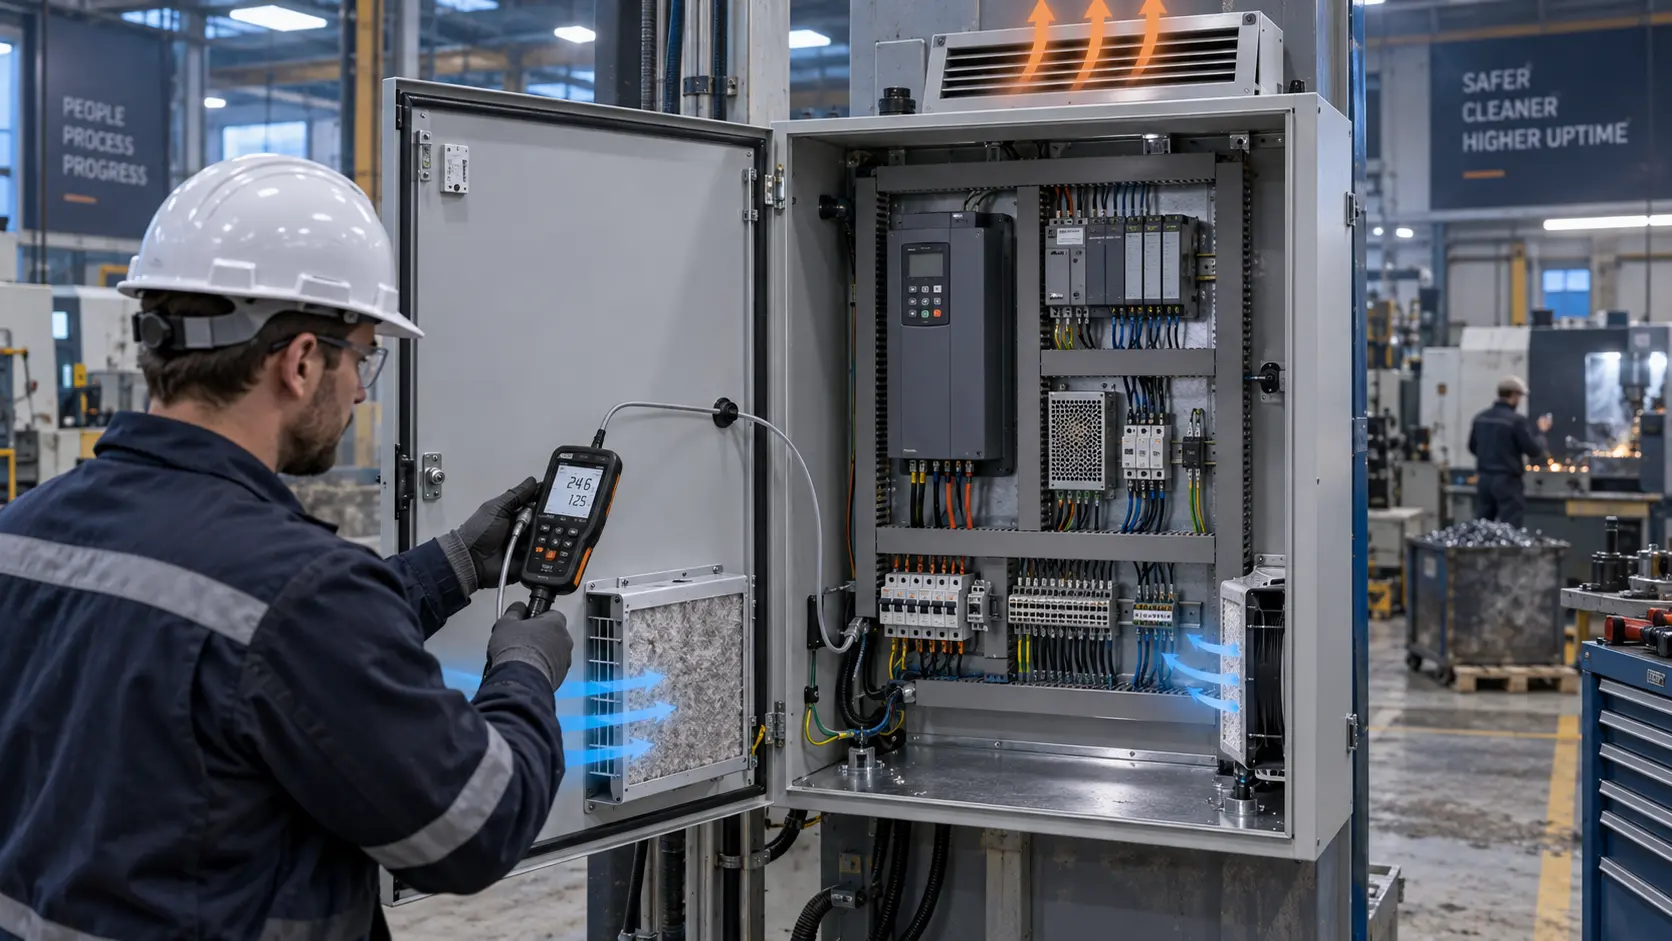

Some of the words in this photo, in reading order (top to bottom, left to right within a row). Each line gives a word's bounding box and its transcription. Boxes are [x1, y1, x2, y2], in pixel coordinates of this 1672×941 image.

[1462, 67, 1531, 93] SAFER
[63, 96, 126, 127] PEOPLE
[1462, 97, 1558, 123] CLEANER
[63, 125, 135, 156] PROCESS
[1462, 128, 1541, 152] HIGHER
[1546, 121, 1629, 148] UPTIME
[63, 153, 148, 187] PROGRESS
